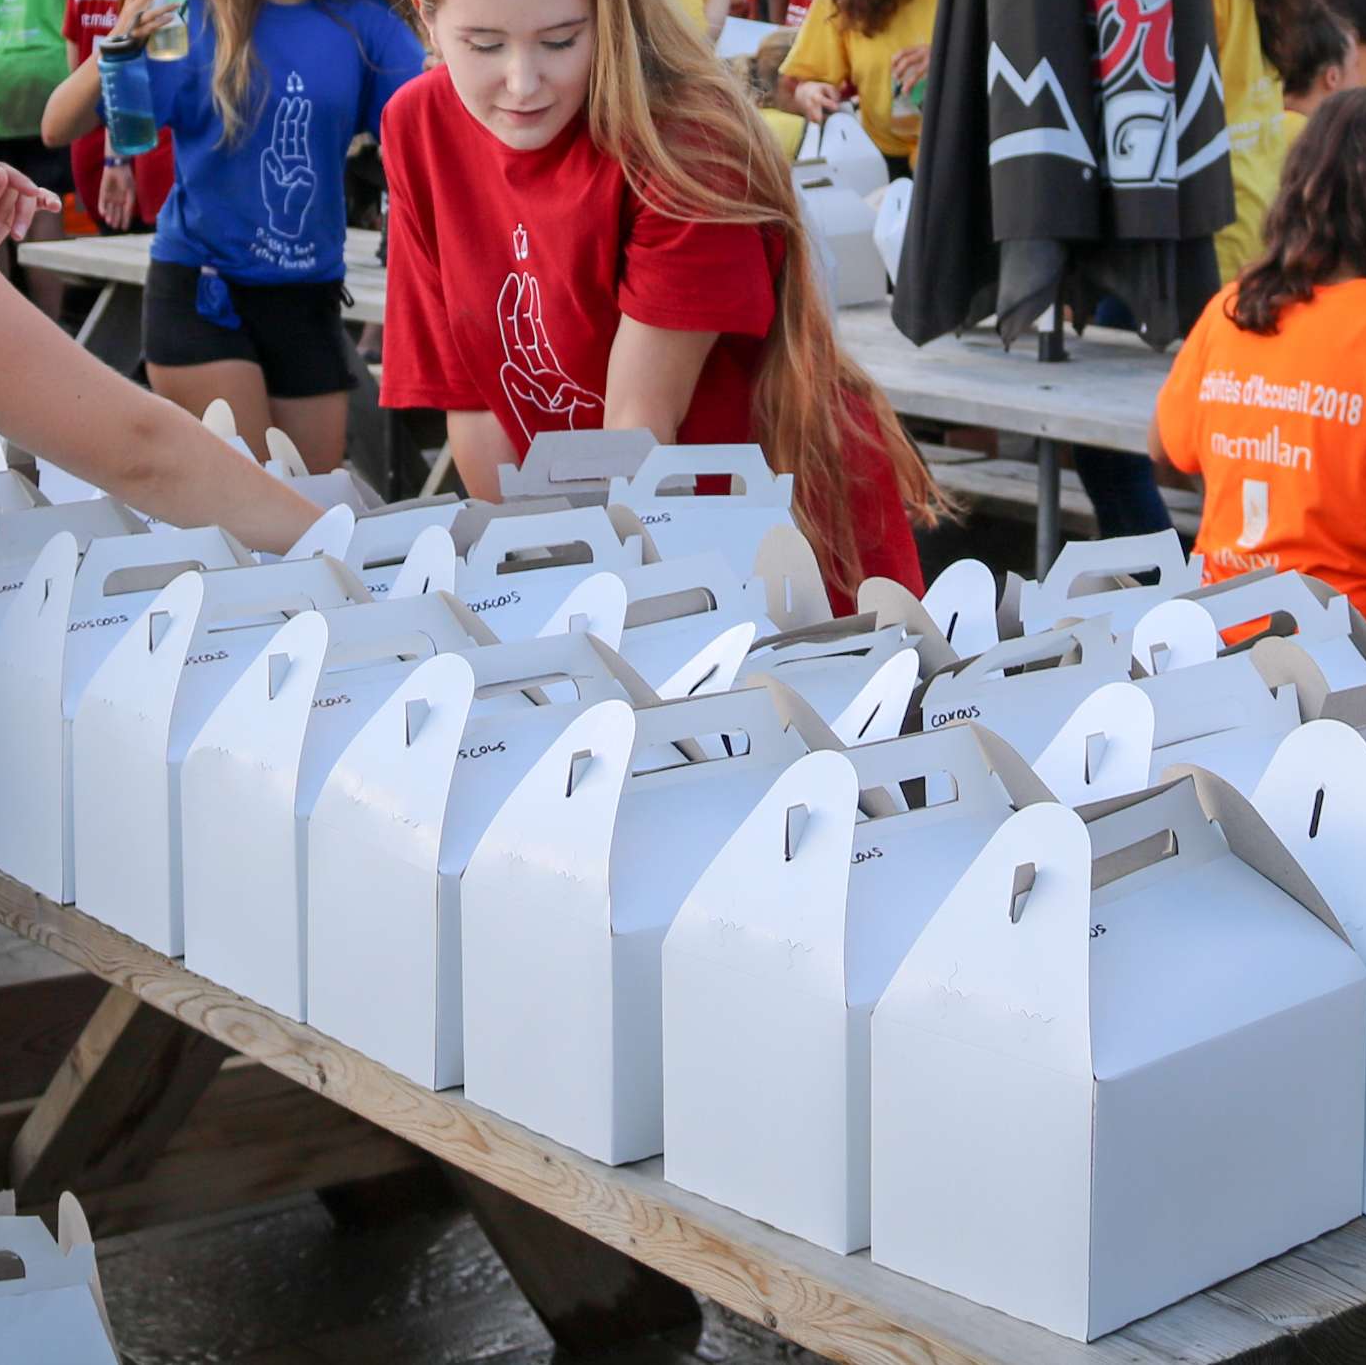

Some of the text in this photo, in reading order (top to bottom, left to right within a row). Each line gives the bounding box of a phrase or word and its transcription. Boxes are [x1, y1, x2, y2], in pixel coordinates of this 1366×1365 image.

[1243, 374, 1311, 414] d'Accueil
[1310, 385, 1364, 426] 2018
[1211, 425, 1312, 472] mcmillan
